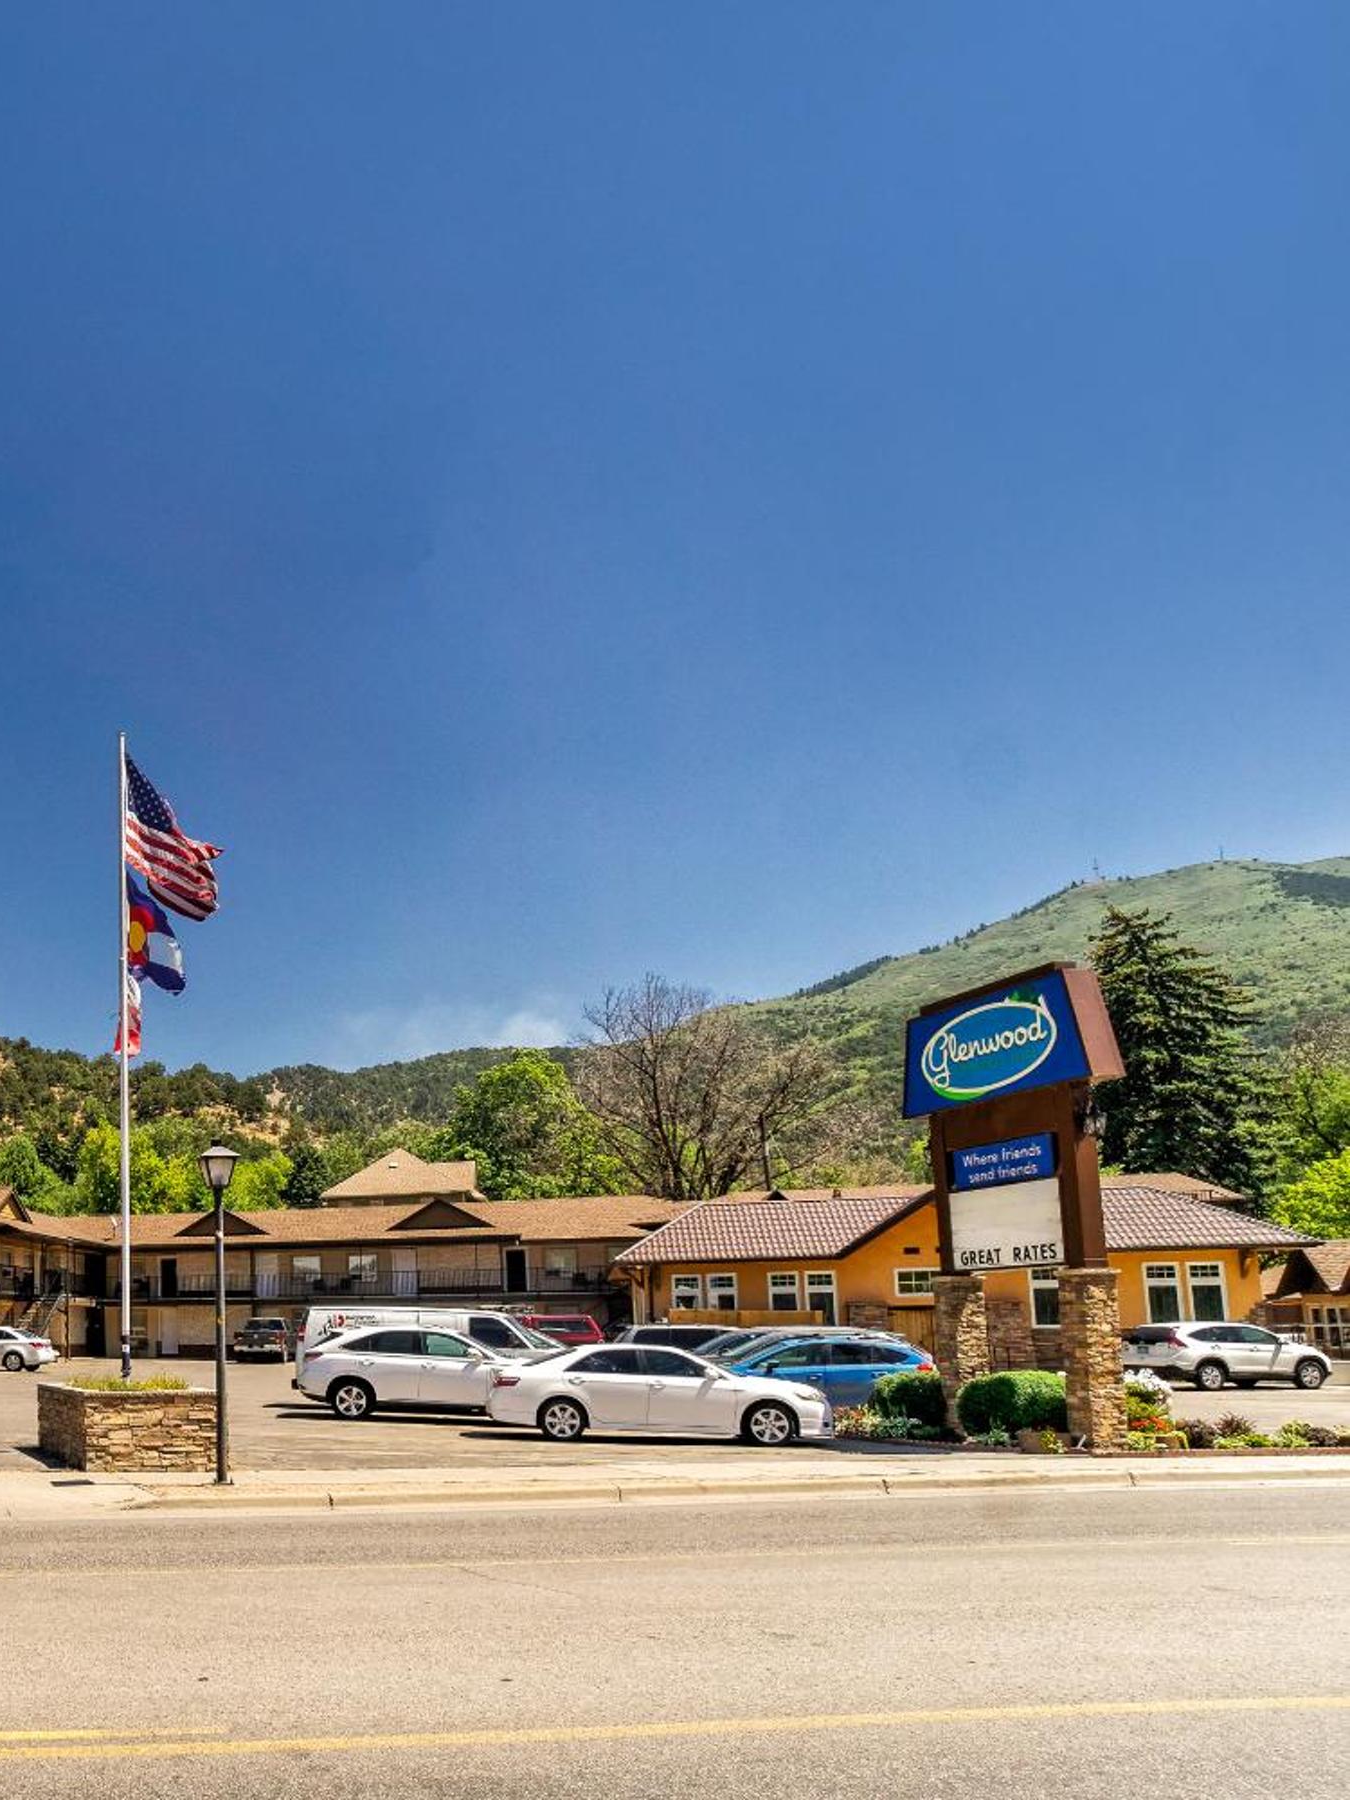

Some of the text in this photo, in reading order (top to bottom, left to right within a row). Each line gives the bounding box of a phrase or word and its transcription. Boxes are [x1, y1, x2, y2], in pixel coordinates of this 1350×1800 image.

[929, 1009, 1048, 1088] Glenwood
[962, 1143, 1042, 1167] Where friends
[968, 1161, 1038, 1184] send friends
[960, 1243, 1057, 1266] GREAT RATES
